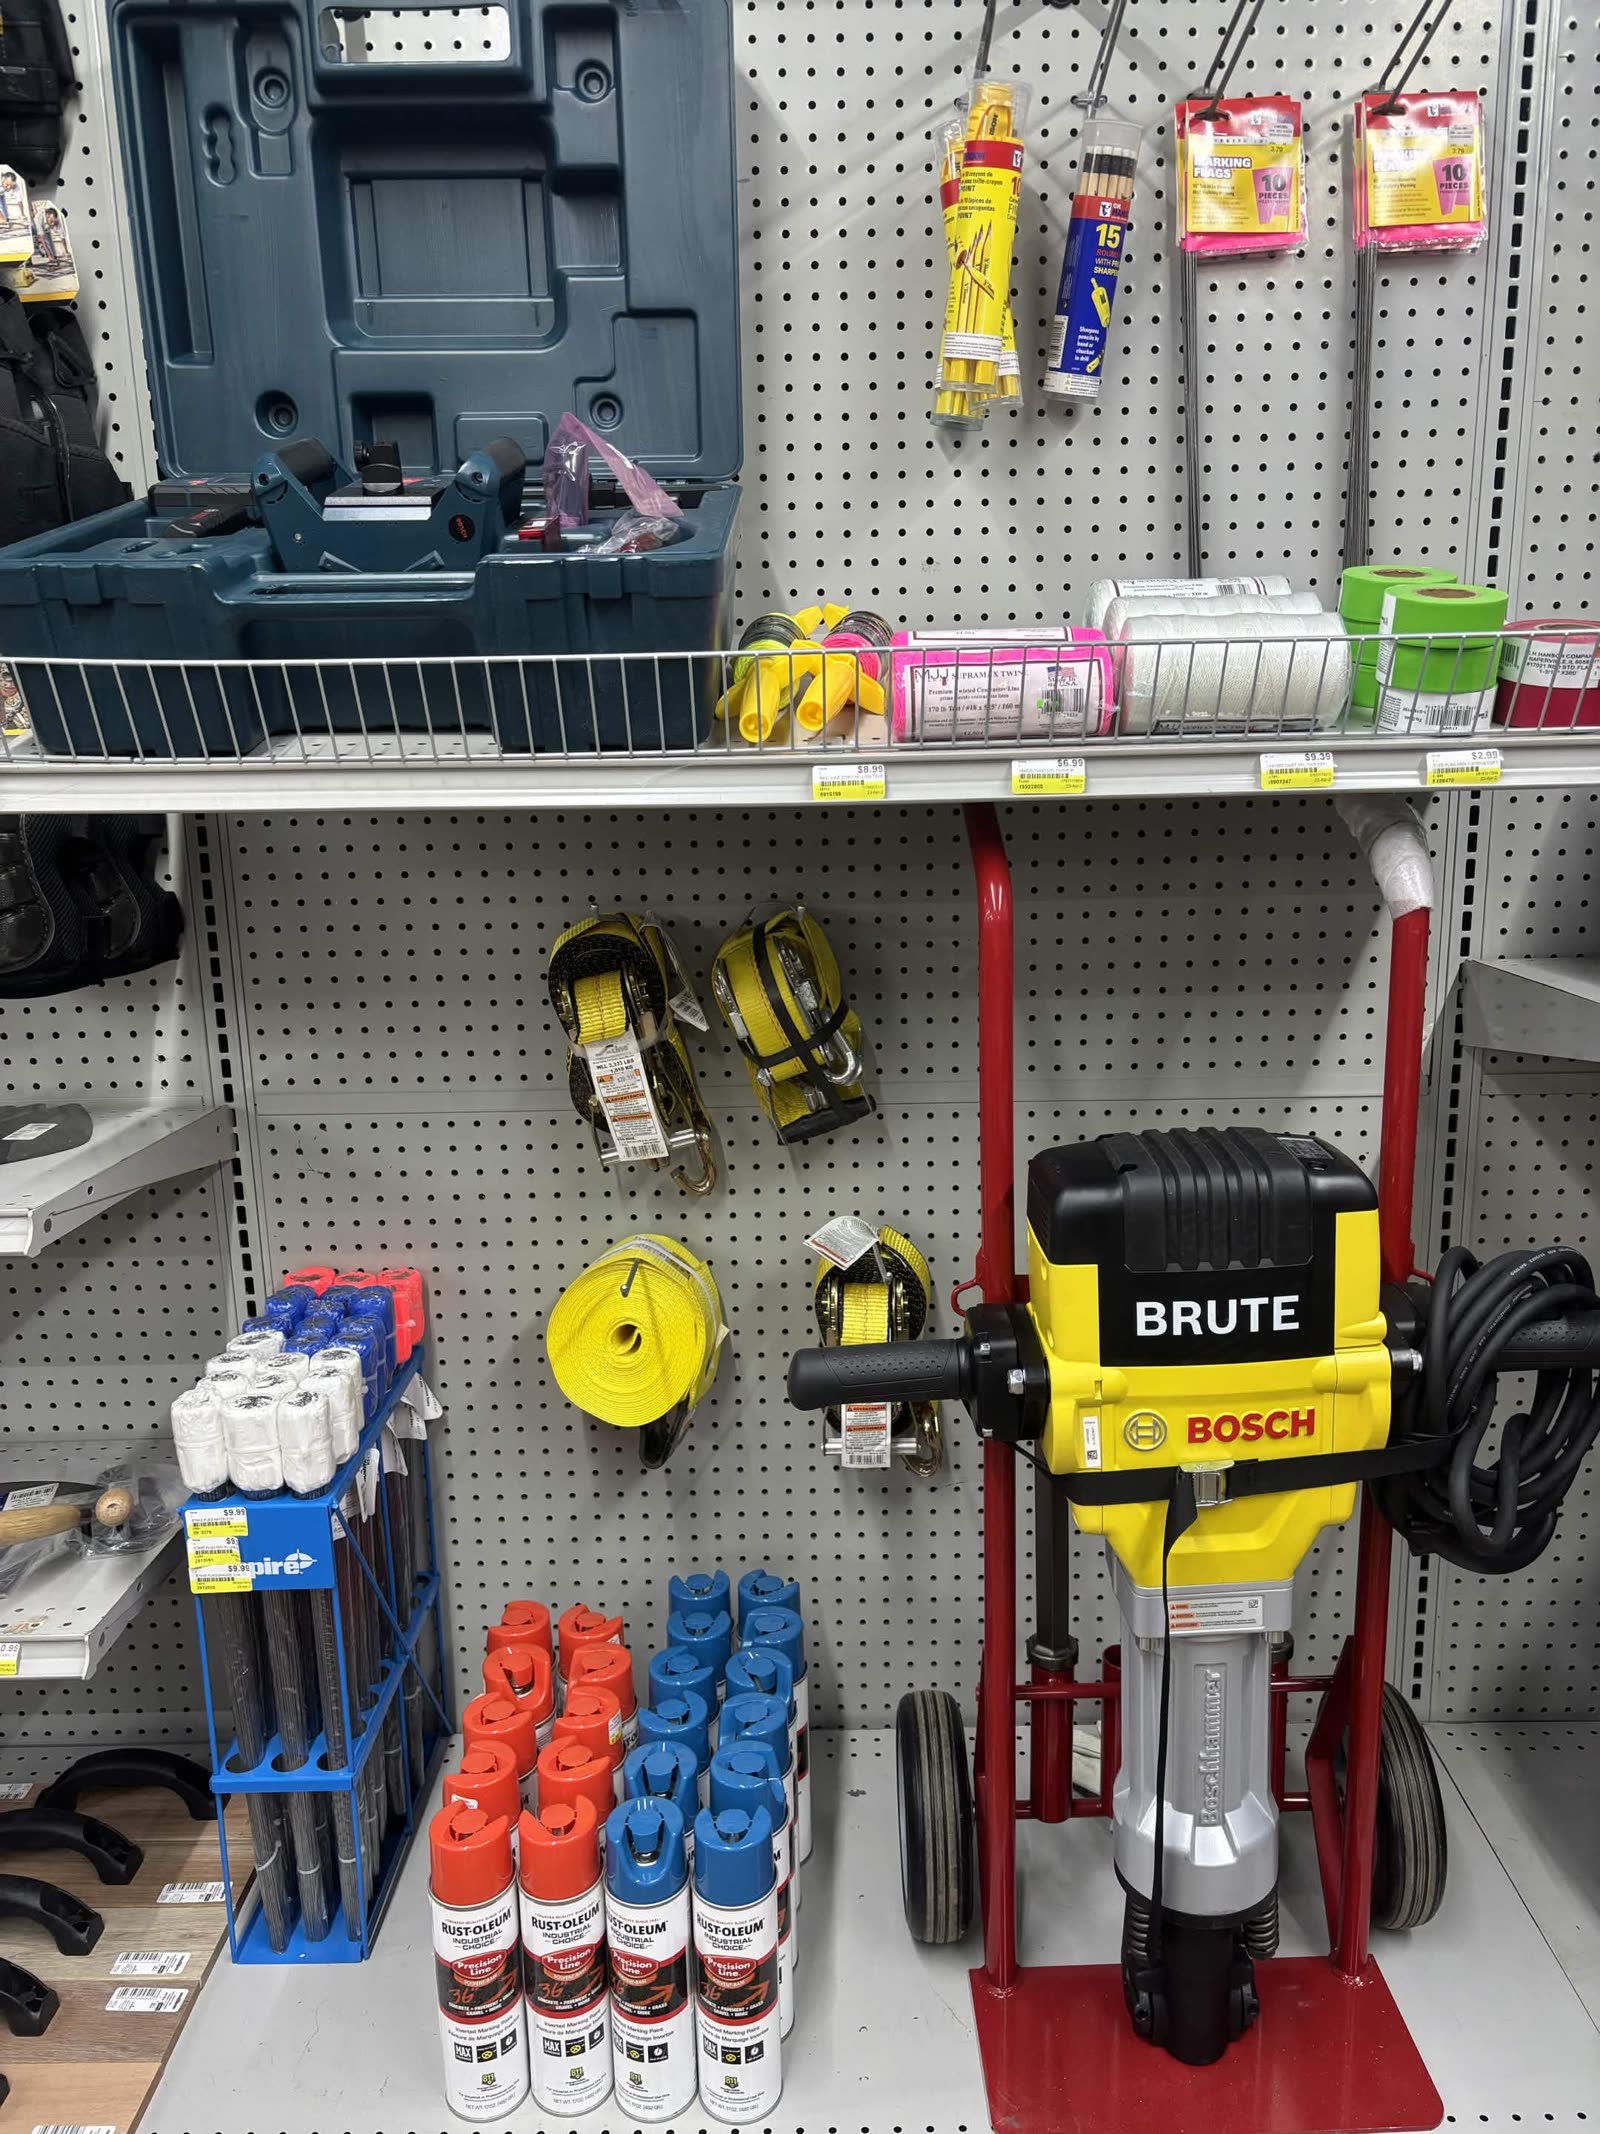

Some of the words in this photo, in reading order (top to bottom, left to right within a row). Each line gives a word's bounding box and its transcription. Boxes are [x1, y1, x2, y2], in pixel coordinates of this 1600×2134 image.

[1442, 164, 1466, 181] 10
[1261, 174, 1286, 191] 10
[1258, 192, 1288, 200] PIECES
[1096, 223, 1121, 248] 15
[1095, 257, 1111, 265] WITH
[1304, 752, 1331, 761] $9.39
[1471, 751, 1498, 760] $2.99
[1057, 758, 1083, 767] $6.99
[857, 765, 883, 774] $8.99
[1135, 1295, 1300, 1337] BRUTE
[1187, 1408, 1315, 1444] BOSCH
[223, 1508, 246, 1516] $9.99
[227, 1565, 250, 1573] $9.99
[441, 1908, 511, 1937] RUST-OLEUM
[531, 1902, 600, 1931] RUST-OLEUM
[608, 1911, 666, 1935] UST-OLEUM
[542, 1923, 592, 1938] INDUSTRIAL
[696, 1912, 764, 1937] RUST-OLEUM
[452, 1929, 503, 1944] INDUSTRIAL
[552, 1933, 585, 1945] CHOICE
[610, 1924, 654, 1943] INDUSTRIAL
[704, 1932, 753, 1945] INDUSTRIAL
[462, 1938, 495, 1950] CHOICE
[616, 1936, 645, 1949] CHOICE
[711, 1942, 744, 1951] CHOICE
[457, 1954, 502, 1969] Precision
[547, 1948, 591, 1964] Precision
[613, 1950, 651, 1968] Precision
[560, 1960, 581, 1970] Line
[621, 1961, 640, 1974] Line
[707, 1957, 750, 1970] Precision
[470, 1966, 491, 1976] Line
[718, 1967, 739, 1977] Line
[477, 2024, 500, 2033] Marking
[566, 2019, 588, 2028] Marking
[626, 2025, 648, 2034] Marking
[722, 2028, 745, 2036] Marking
[456, 2044, 471, 2057] MAX
[544, 2039, 560, 2052] MAX
